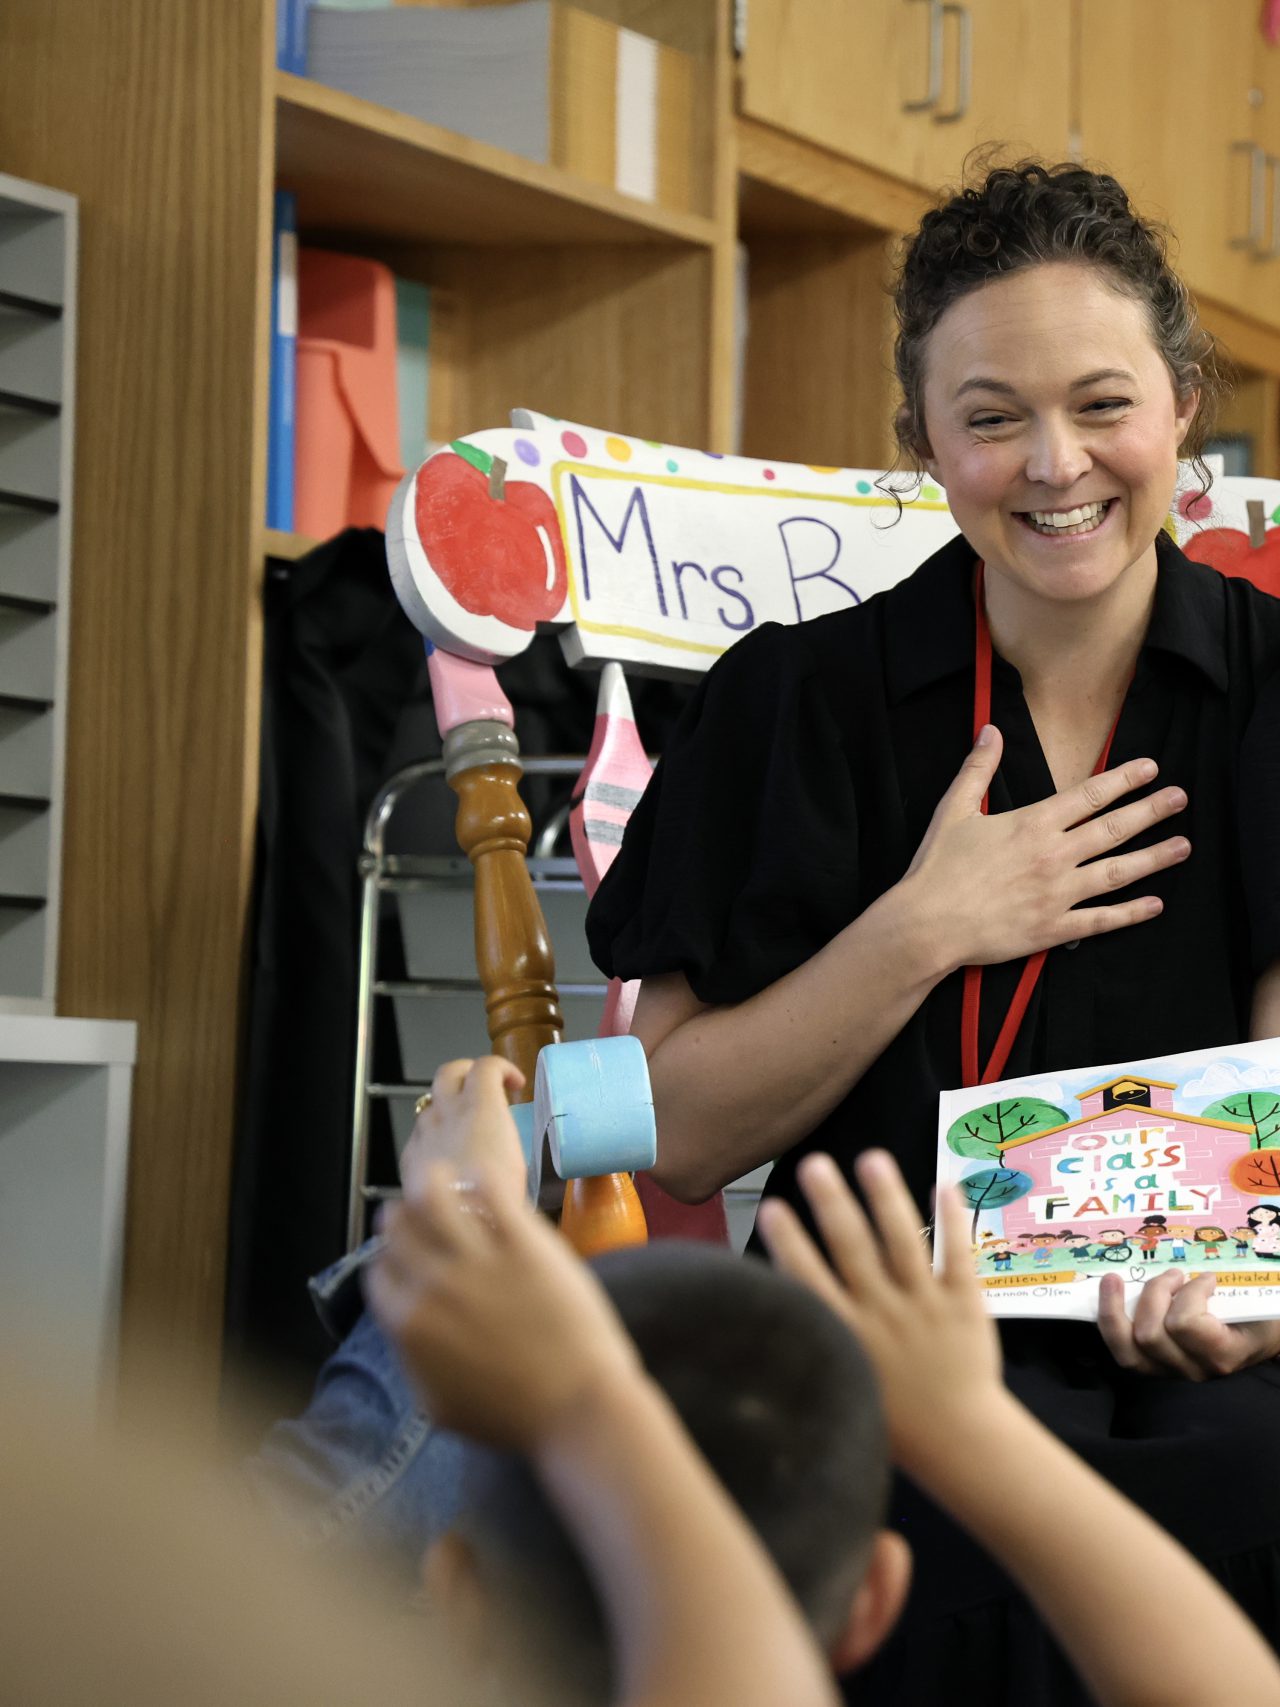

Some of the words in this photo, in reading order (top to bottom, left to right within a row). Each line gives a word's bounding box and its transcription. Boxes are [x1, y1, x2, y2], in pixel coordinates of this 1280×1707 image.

[569, 472, 756, 632] Mrs
[1090, 1177, 1118, 1192] is
[1134, 1173, 1159, 1190] a
[1045, 1186, 1218, 1220] FAMILY
[986, 1277, 1037, 1286] written
[1042, 1274, 1057, 1283] by
[986, 1289, 1029, 1298] hannon
